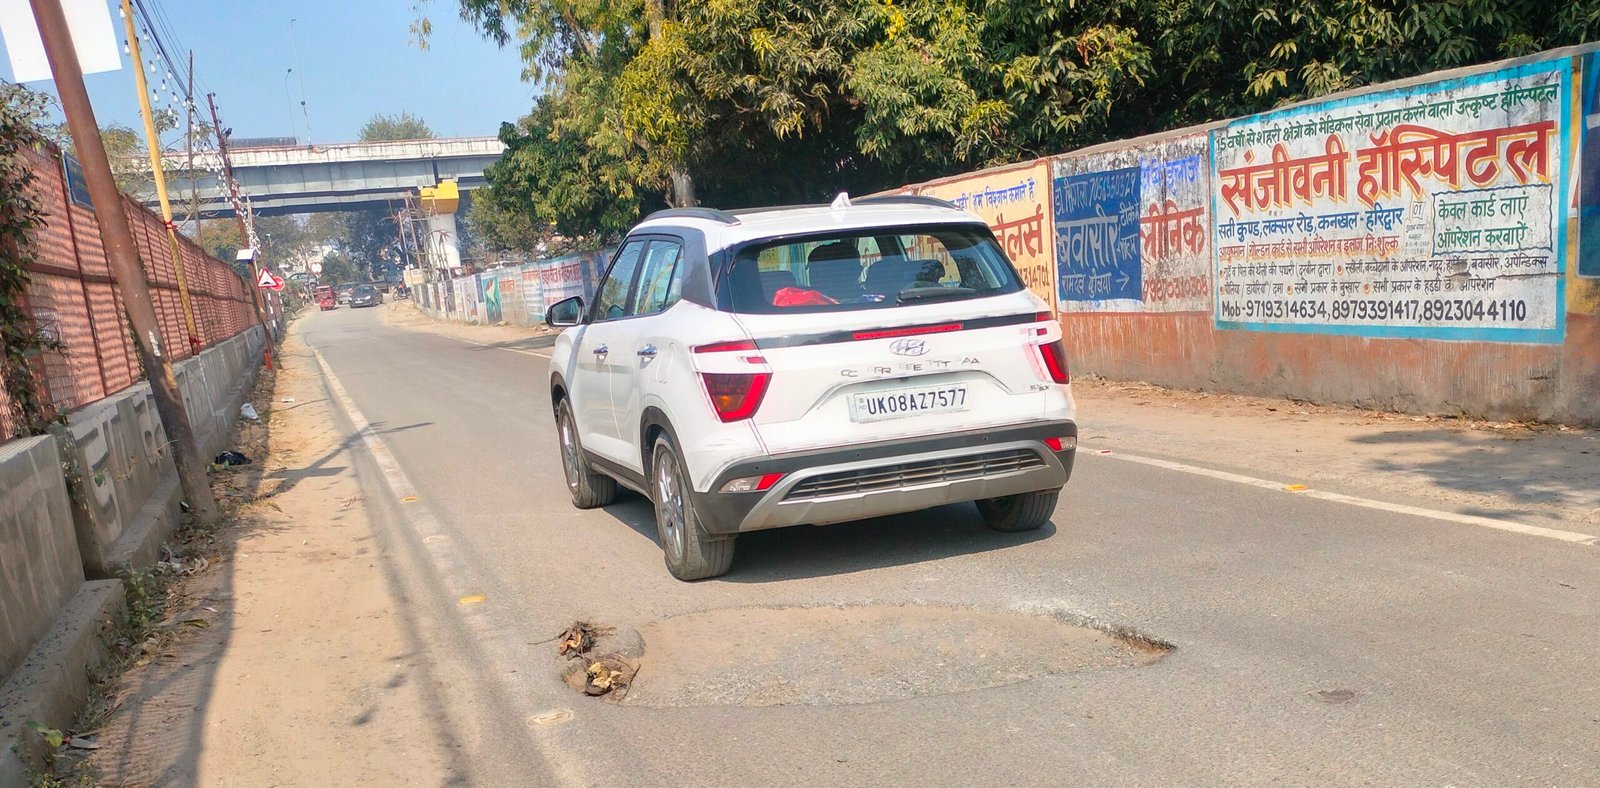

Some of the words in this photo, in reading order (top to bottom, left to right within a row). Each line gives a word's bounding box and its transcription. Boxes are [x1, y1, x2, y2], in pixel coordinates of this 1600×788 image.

[1217, 139, 1226, 151] 15
[1257, 124, 1281, 148] शहरी
[1304, 120, 1317, 136] को
[1318, 115, 1354, 134] मेडिकल
[1355, 111, 1374, 130] सेवा
[1375, 108, 1400, 130] प्रदान
[1403, 101, 1427, 122] करने
[1428, 100, 1455, 121] वाला
[1220, 132, 1350, 217] संजीवनी
[1356, 120, 1558, 204] हॉस्पिटल
[1439, 200, 1467, 220] केवल
[1471, 193, 1496, 217] कार्ड
[1219, 217, 1235, 239] सती
[1366, 204, 1404, 231] हरिद्वार
[1056, 204, 1118, 268] बवासीर
[1438, 228, 1481, 249] ऑपरेशन
[1269, 262, 1277, 275] की
[1310, 282, 1329, 294] प्रकार
[1331, 279, 1338, 292] के
[1373, 277, 1389, 293] सभी
[1391, 281, 1412, 293] प्रकार
[1414, 277, 1421, 291] के
[867, 388, 967, 415] UK08AZ7577
